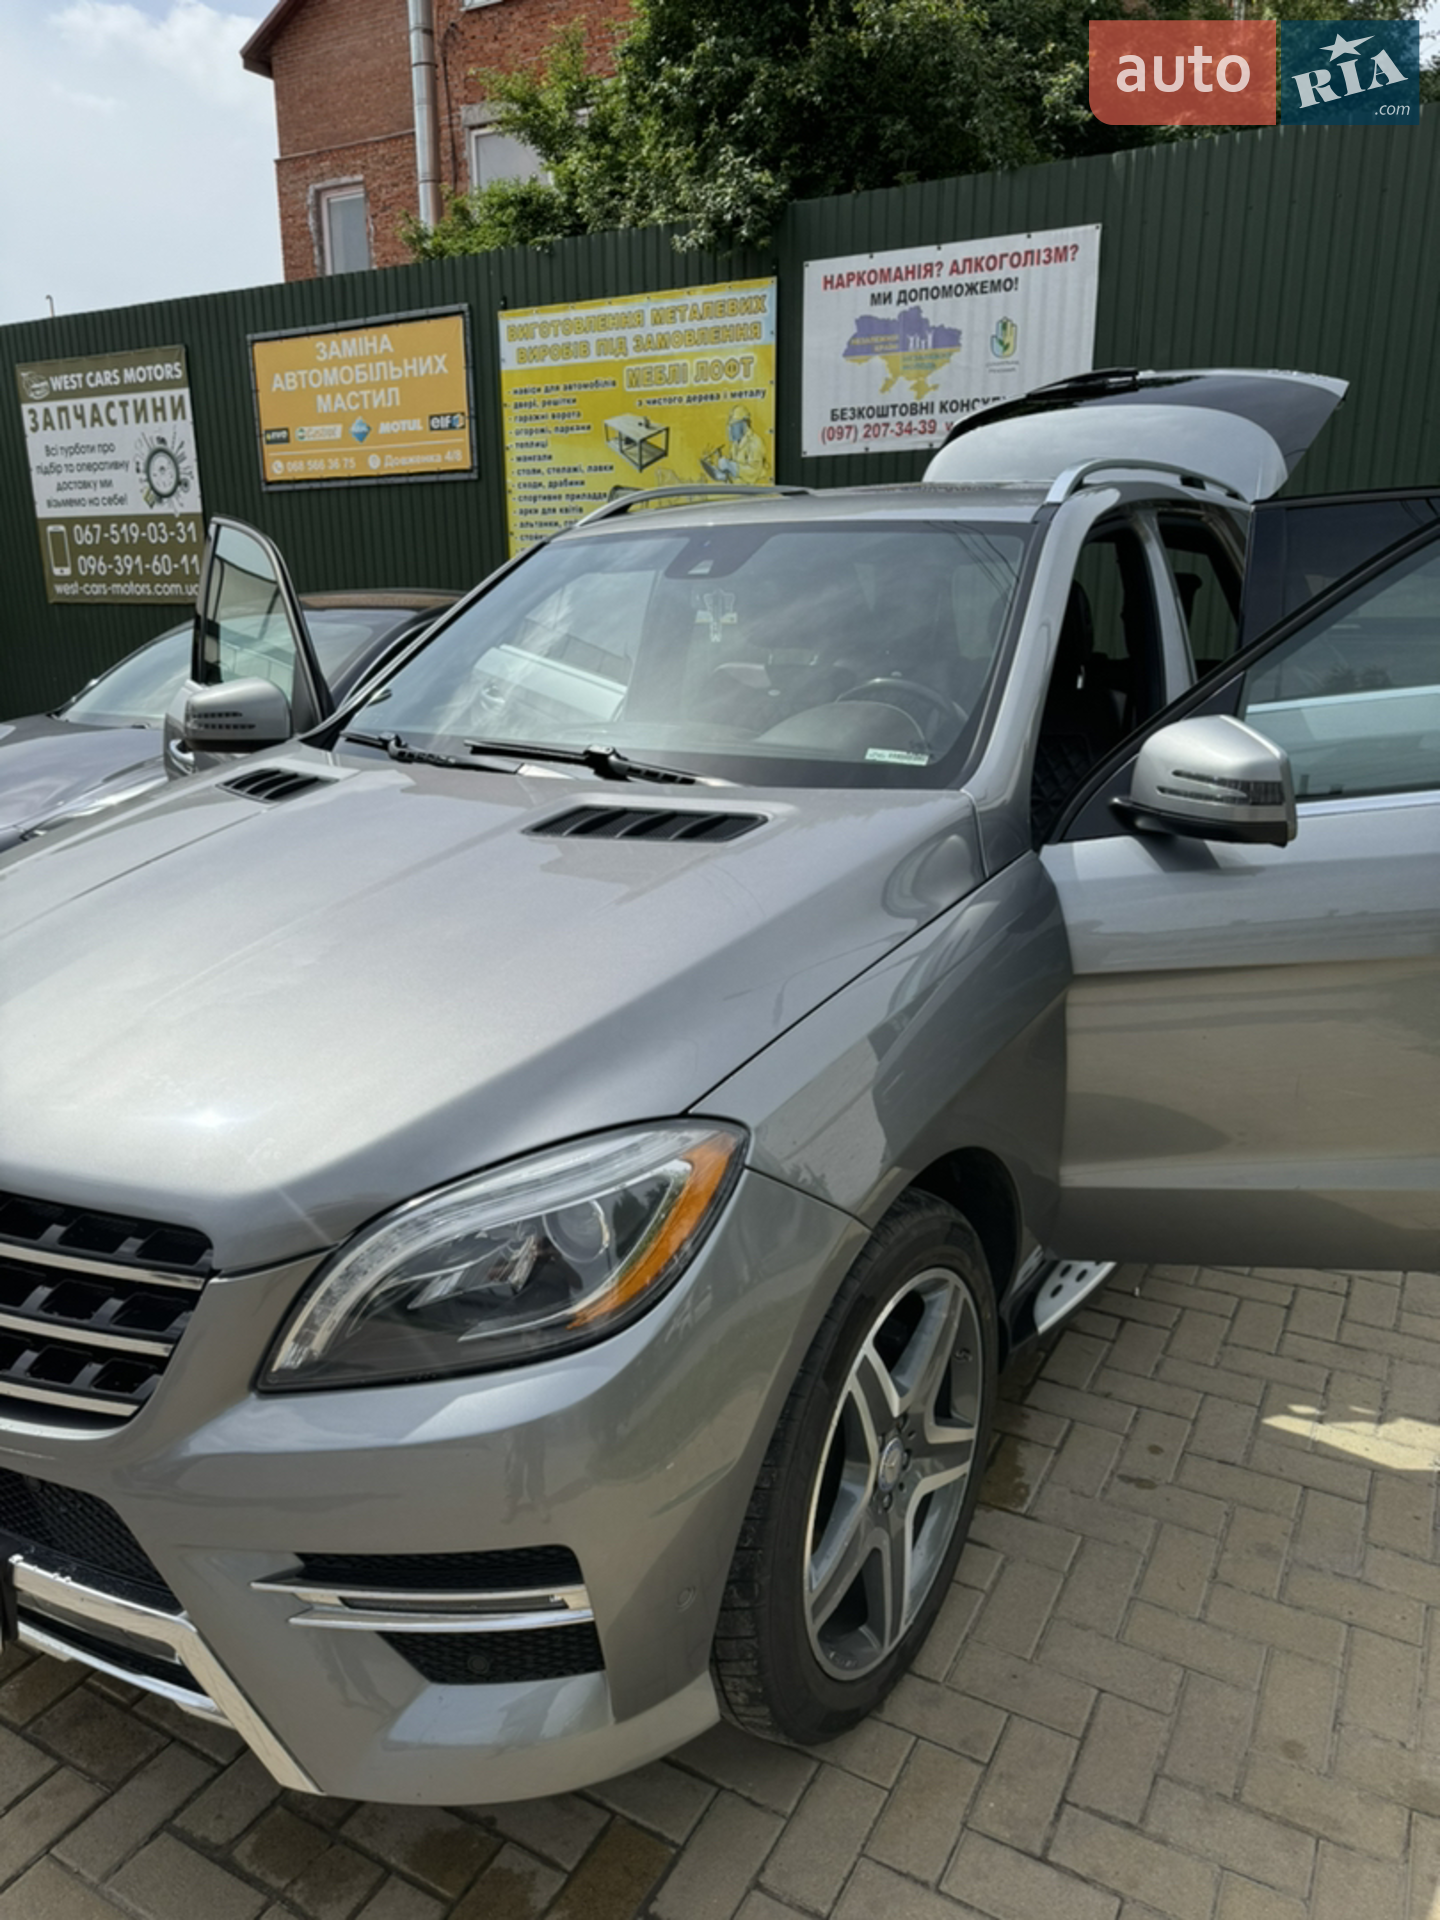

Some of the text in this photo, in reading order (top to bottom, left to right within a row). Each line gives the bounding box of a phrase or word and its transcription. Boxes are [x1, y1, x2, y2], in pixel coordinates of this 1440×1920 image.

[822, 243, 1079, 291] НАРКОМАНІЯ? АЛКОГОЛІЗМ?
[870, 277, 1019, 307] МИ ДОПОМОЖЕМО!
[507, 294, 767, 342] ВИГОТОВЛЕННЯ МЕТАЛЕВИХ
[315, 334, 394, 361] ЗАМІНА
[516, 322, 762, 364] ВИРОБІВ ПІД ЗАМОВЛЕННЯ
[50, 372, 83, 392] WEST
[85, 369, 120, 388] CARS
[123, 362, 182, 384] MOTORS
[271, 354, 448, 392] АВТОМОБІЛЬНИХ
[626, 357, 754, 389] МЕБЛІ ЛОФТ
[316, 387, 400, 413] МАСТИЛ
[686, 393, 721, 404] дерева
[730, 388, 766, 399] металу
[28, 394, 187, 433] ЗАПЧАСТИНИ
[431, 416, 451, 430] elf
[831, 403, 935, 421] БЕЗКОШТОВНІ
[379, 419, 422, 433] MOTUL
[821, 424, 858, 445] (097)
[863, 419, 937, 439] 207-34-39
[44, 442, 116, 458] Всі турботи про
[56, 480, 97, 492] доставку
[73, 521, 197, 545] 067-519-03-31
[77, 553, 200, 576] 096-391-60-11
